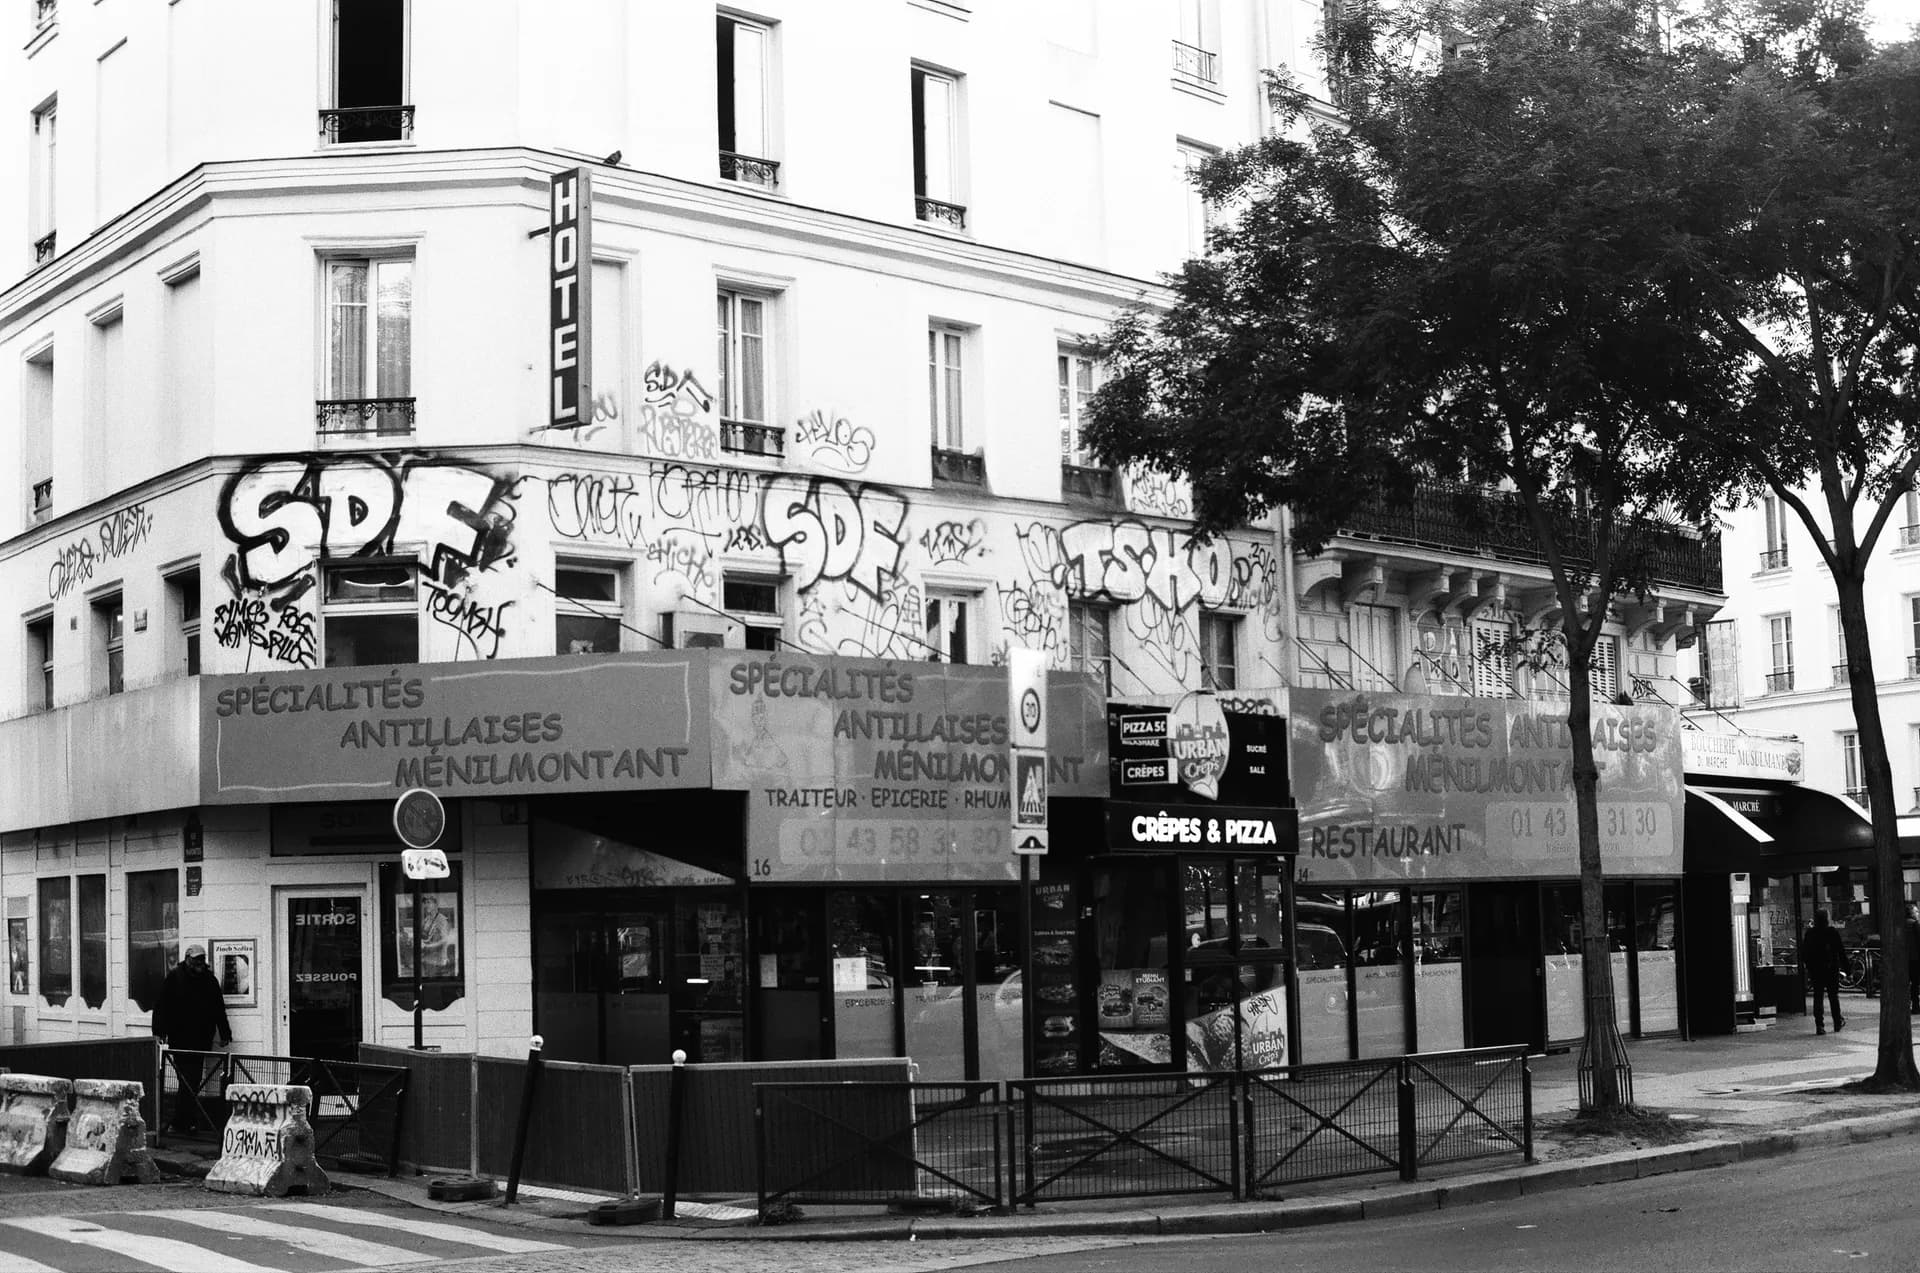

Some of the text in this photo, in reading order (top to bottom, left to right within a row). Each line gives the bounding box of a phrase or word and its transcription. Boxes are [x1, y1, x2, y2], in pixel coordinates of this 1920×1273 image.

[554, 177, 577, 420] HOTEL
[216, 670, 425, 717] SPÉCIALITÉS
[730, 653, 914, 703] SPÉCIALITÉS
[340, 712, 564, 750] ANTILLAISES
[834, 709, 1011, 745] ANTILLAISES
[1123, 722, 1153, 733] PIZZA
[1319, 694, 1657, 753] SPÉCIALITÉS ANTIAISES
[1174, 738, 1227, 760] URBAN
[1690, 734, 1737, 756] BOUCHERIE
[395, 747, 689, 788] MÉNILMONTANT
[874, 743, 1085, 784] MÉNILMONNT
[1127, 763, 1165, 778] CRÊPES
[1405, 746, 1607, 794] MÉNILMONTAT
[765, 787, 857, 807] TRAITEUR
[871, 788, 948, 809] EPICERIE
[1732, 800, 1761, 812] MARCHÉ
[1132, 811, 1277, 845] CRÊPES & PIZZA
[1511, 806, 1657, 838] 01 43 31 30
[847, 826, 876, 855] 43
[890, 826, 920, 855] 58
[1311, 823, 1467, 859] RESTAURANT
[754, 859, 771, 876] 16
[1252, 1037, 1284, 1054] URBAN
